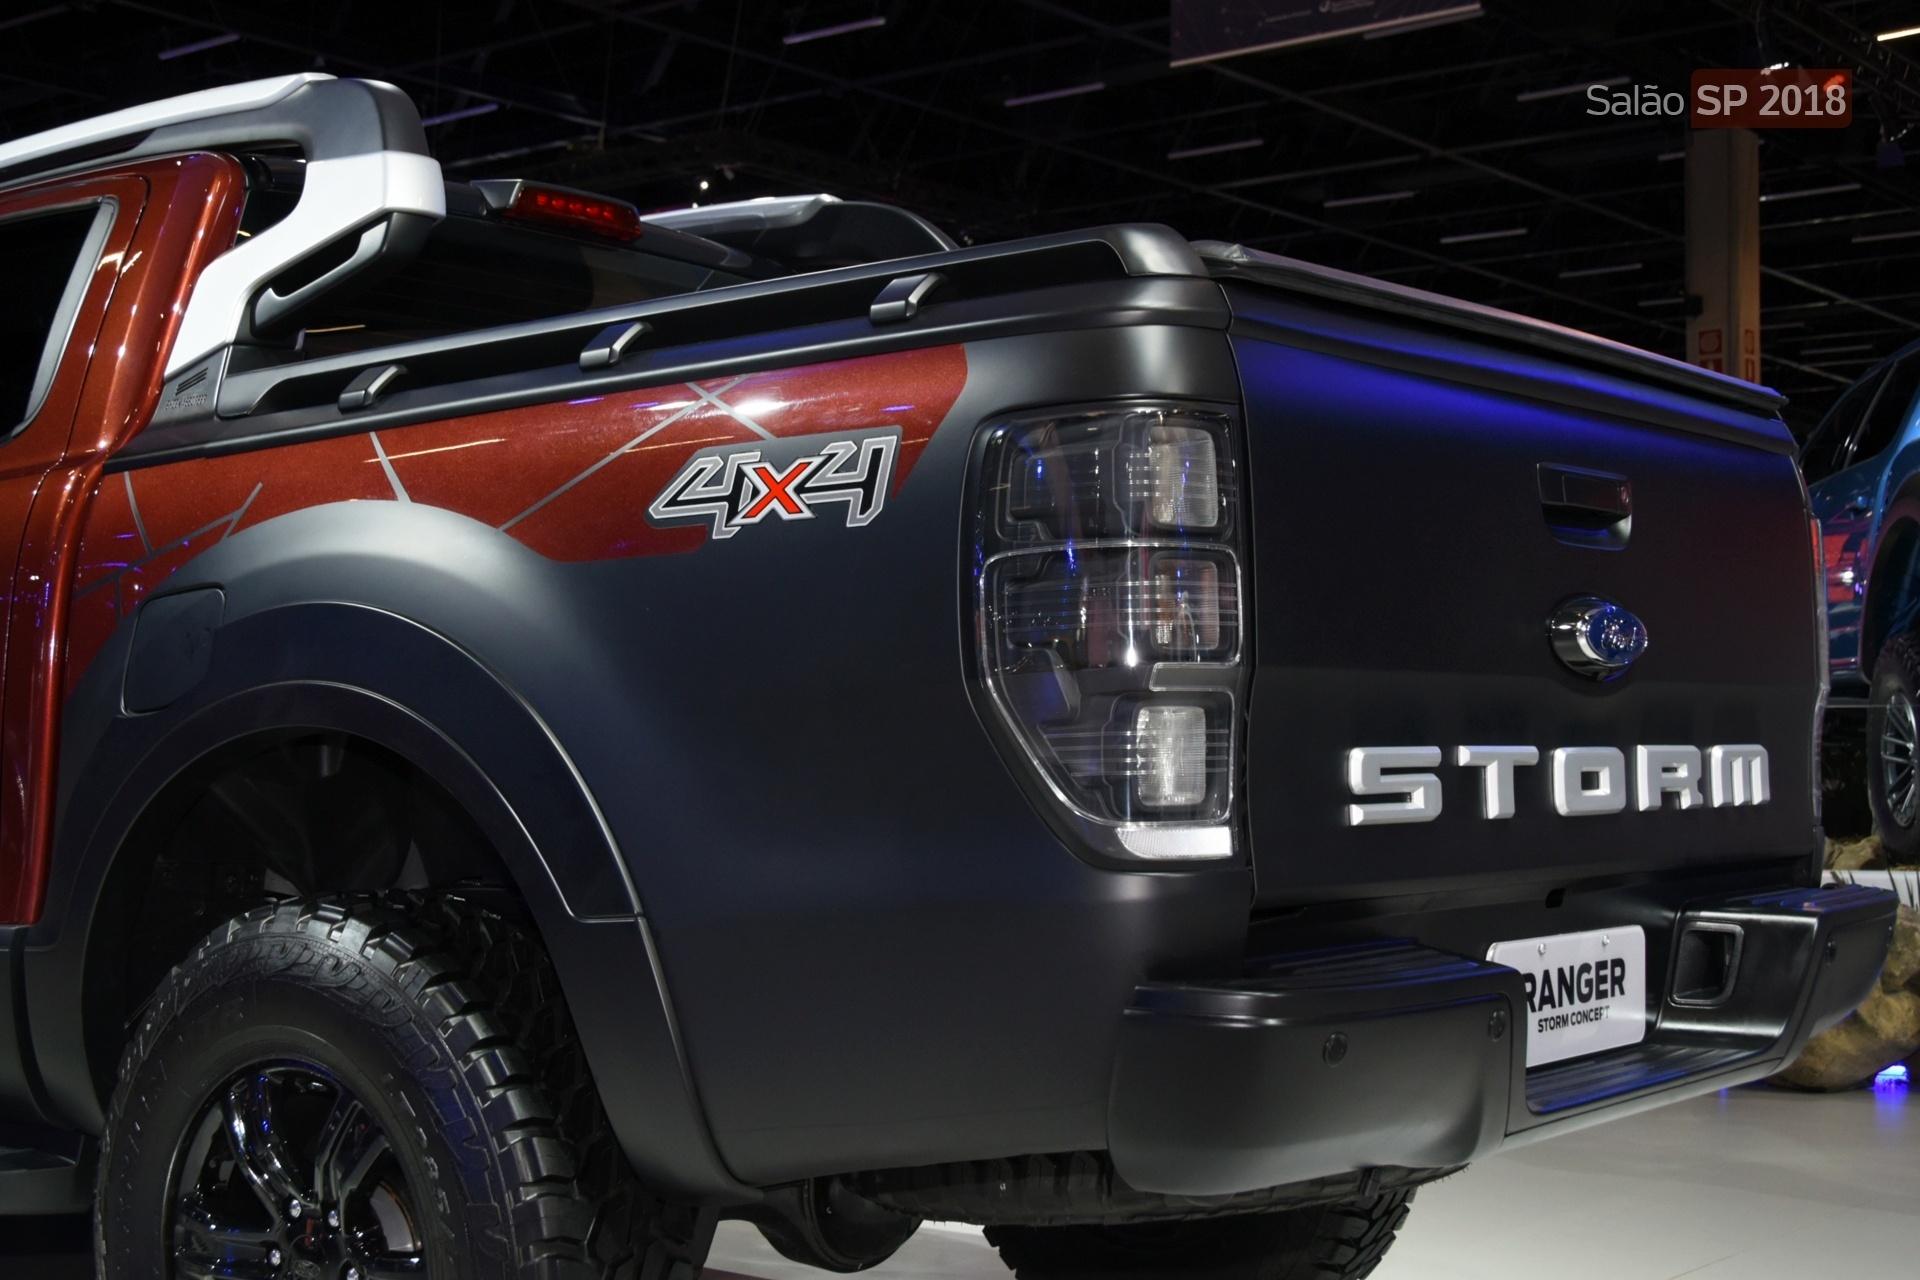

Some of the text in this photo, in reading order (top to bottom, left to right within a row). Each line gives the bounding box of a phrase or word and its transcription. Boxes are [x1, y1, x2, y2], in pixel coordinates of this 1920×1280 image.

[1347, 743, 1772, 828] STORM
[1522, 957, 1626, 1013] RANGER
[1537, 1005, 1610, 1034] STORM CONCEPT
